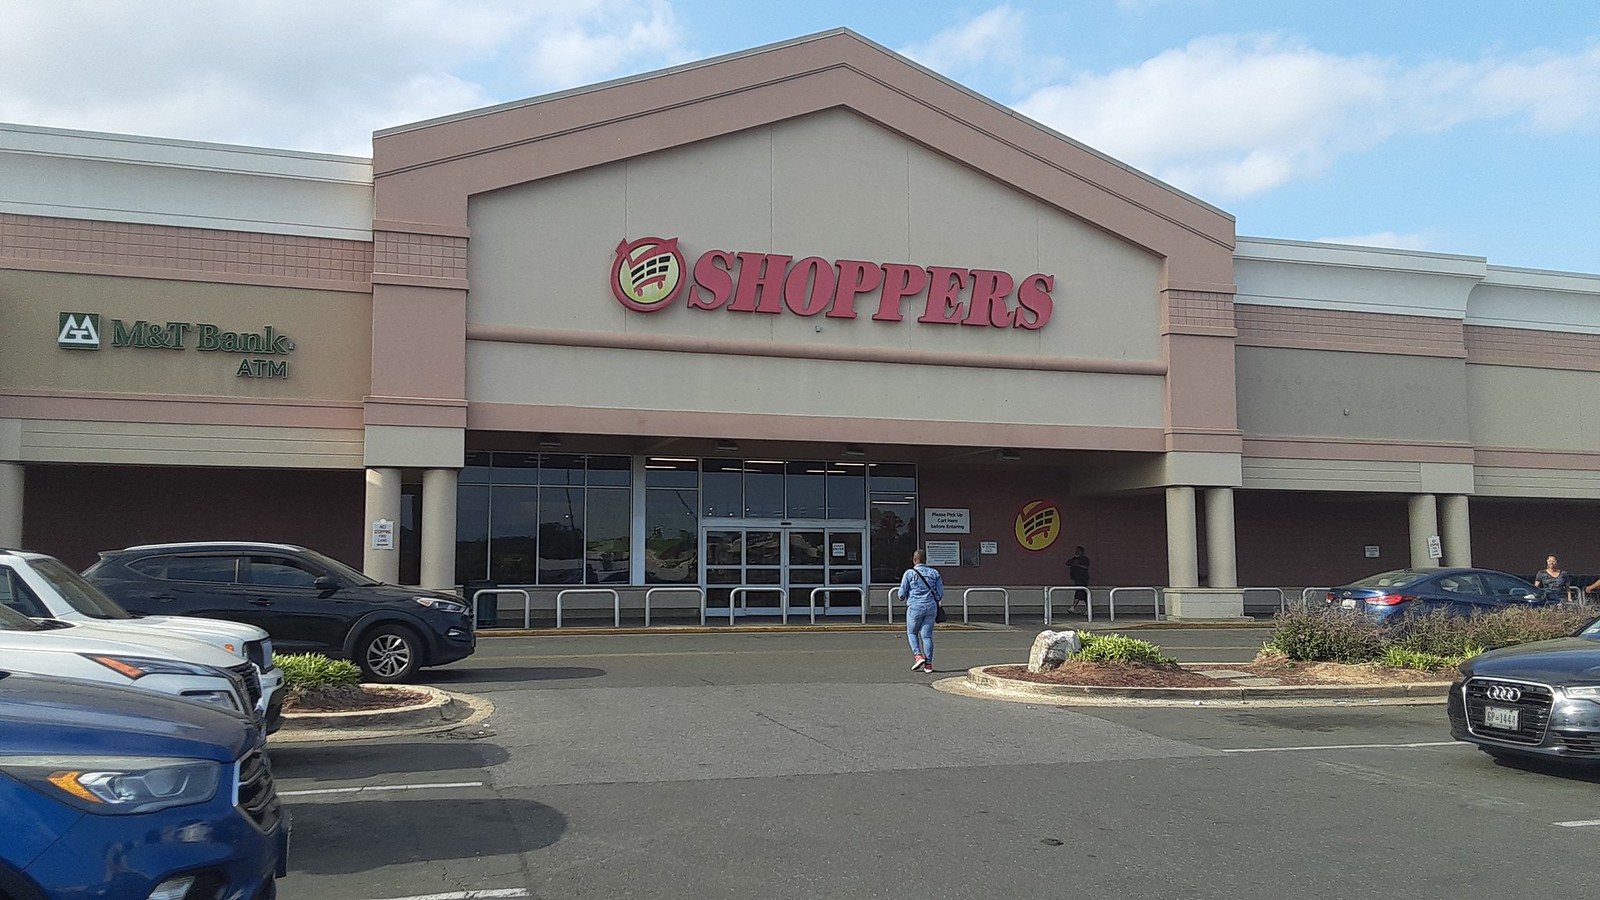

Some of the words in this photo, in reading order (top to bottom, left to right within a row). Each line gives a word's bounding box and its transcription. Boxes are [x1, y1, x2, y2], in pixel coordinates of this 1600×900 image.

[686, 249, 1055, 330] SHOPPERS
[111, 319, 191, 349] M&T
[196, 323, 289, 354] Bank
[235, 358, 289, 379] ATM
